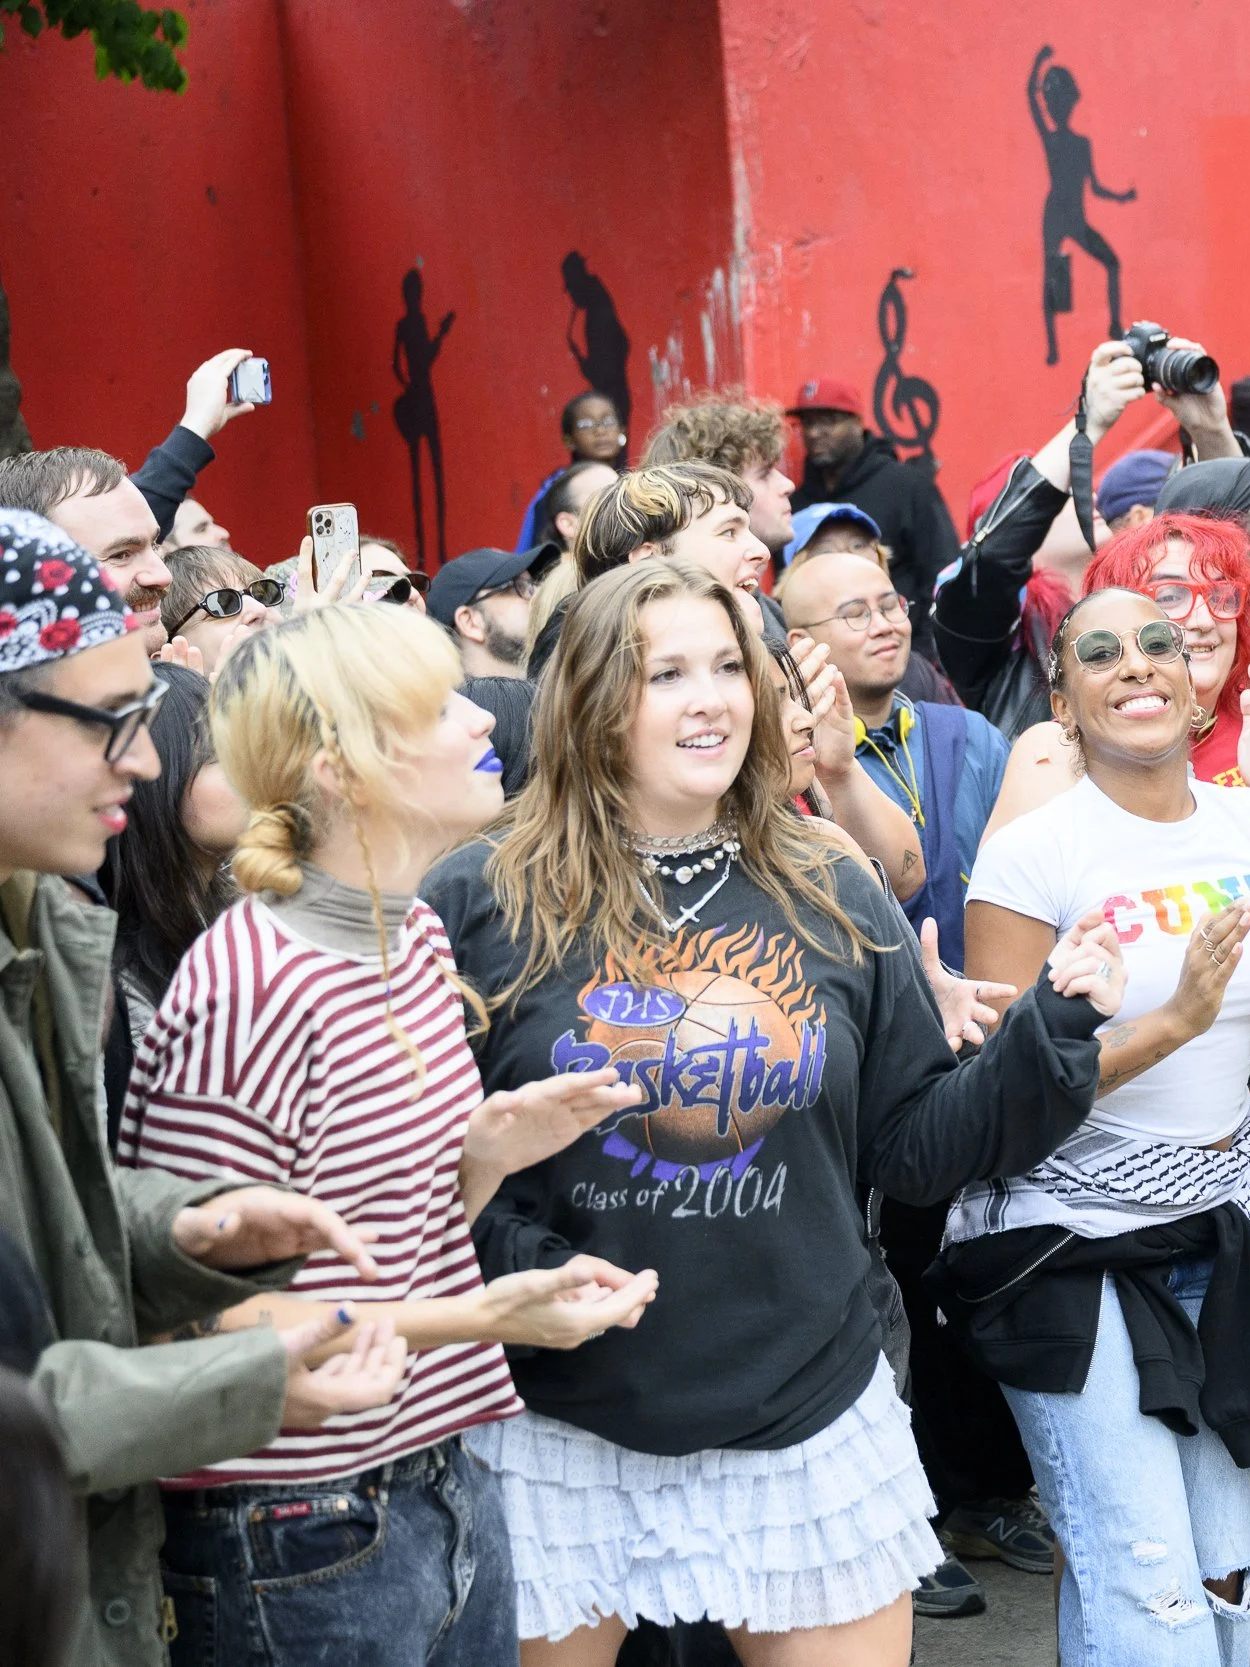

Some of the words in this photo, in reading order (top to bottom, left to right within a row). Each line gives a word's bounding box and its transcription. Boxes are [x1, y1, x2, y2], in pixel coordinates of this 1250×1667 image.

[597, 989, 675, 1021] JHS
[571, 1180, 627, 1210] Class
[636, 1179, 669, 1215] of
[671, 1164, 788, 1219] 2004
